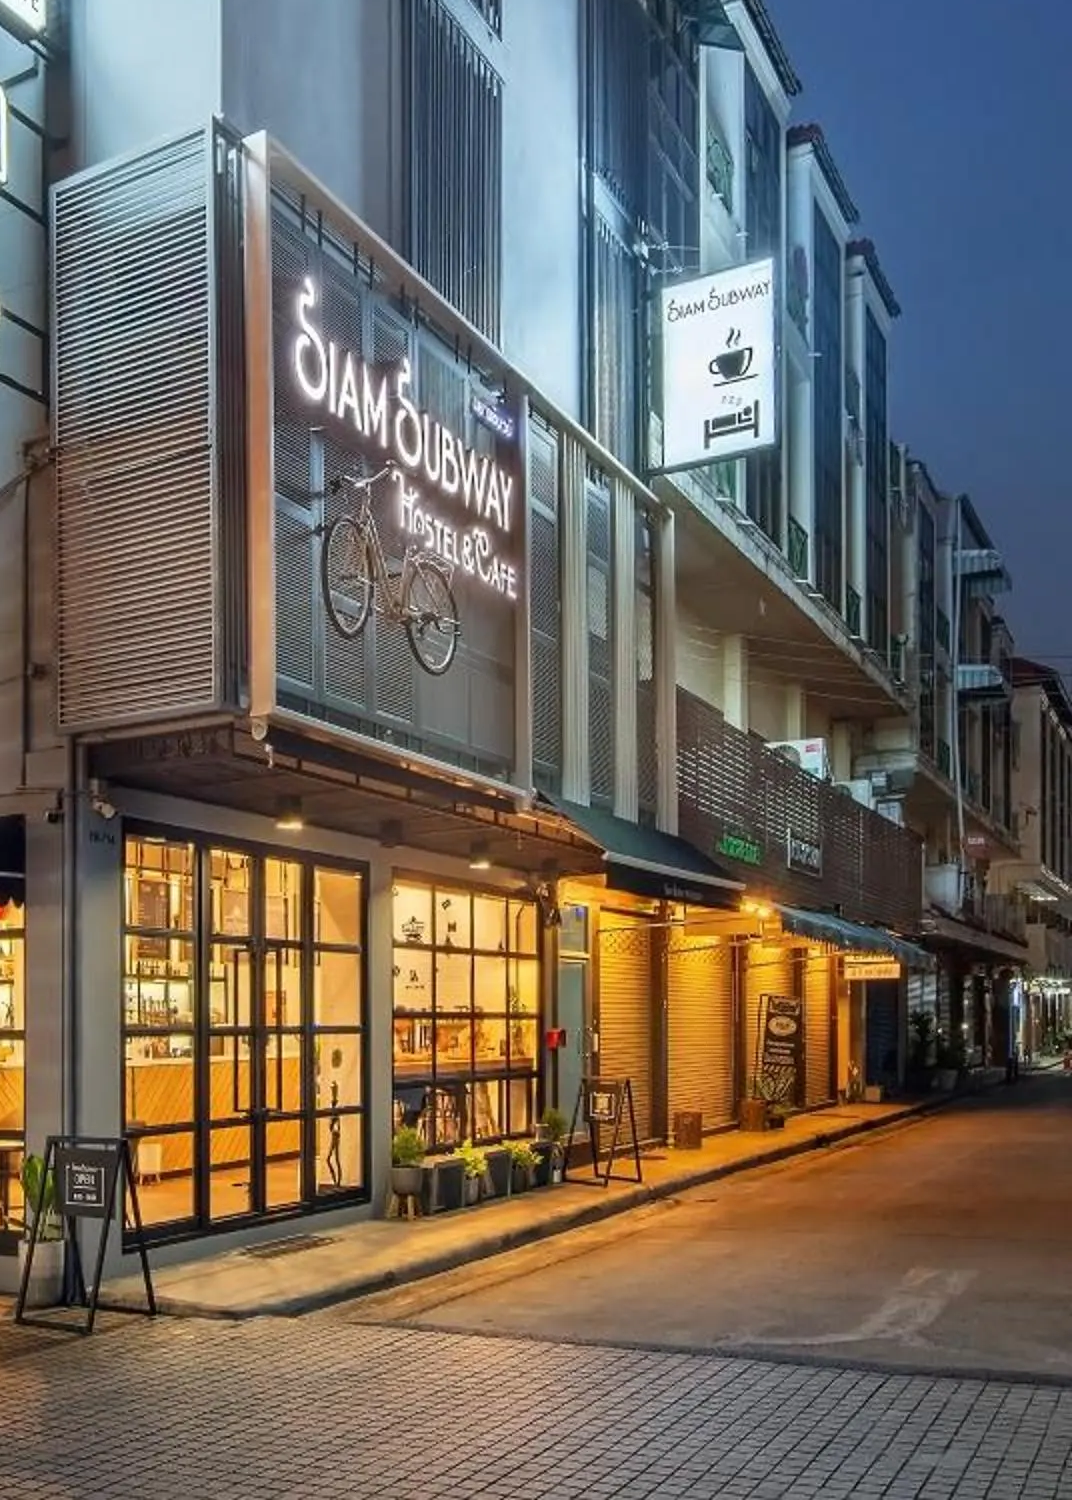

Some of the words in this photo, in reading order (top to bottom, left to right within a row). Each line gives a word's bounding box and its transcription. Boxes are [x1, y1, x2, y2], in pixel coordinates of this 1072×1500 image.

[667, 299, 705, 323] SIAM
[708, 281, 770, 310] SUBWAY
[295, 277, 387, 448] SIAM
[395, 357, 513, 532] SUBWAY
[391, 471, 460, 566] HOSTEL
